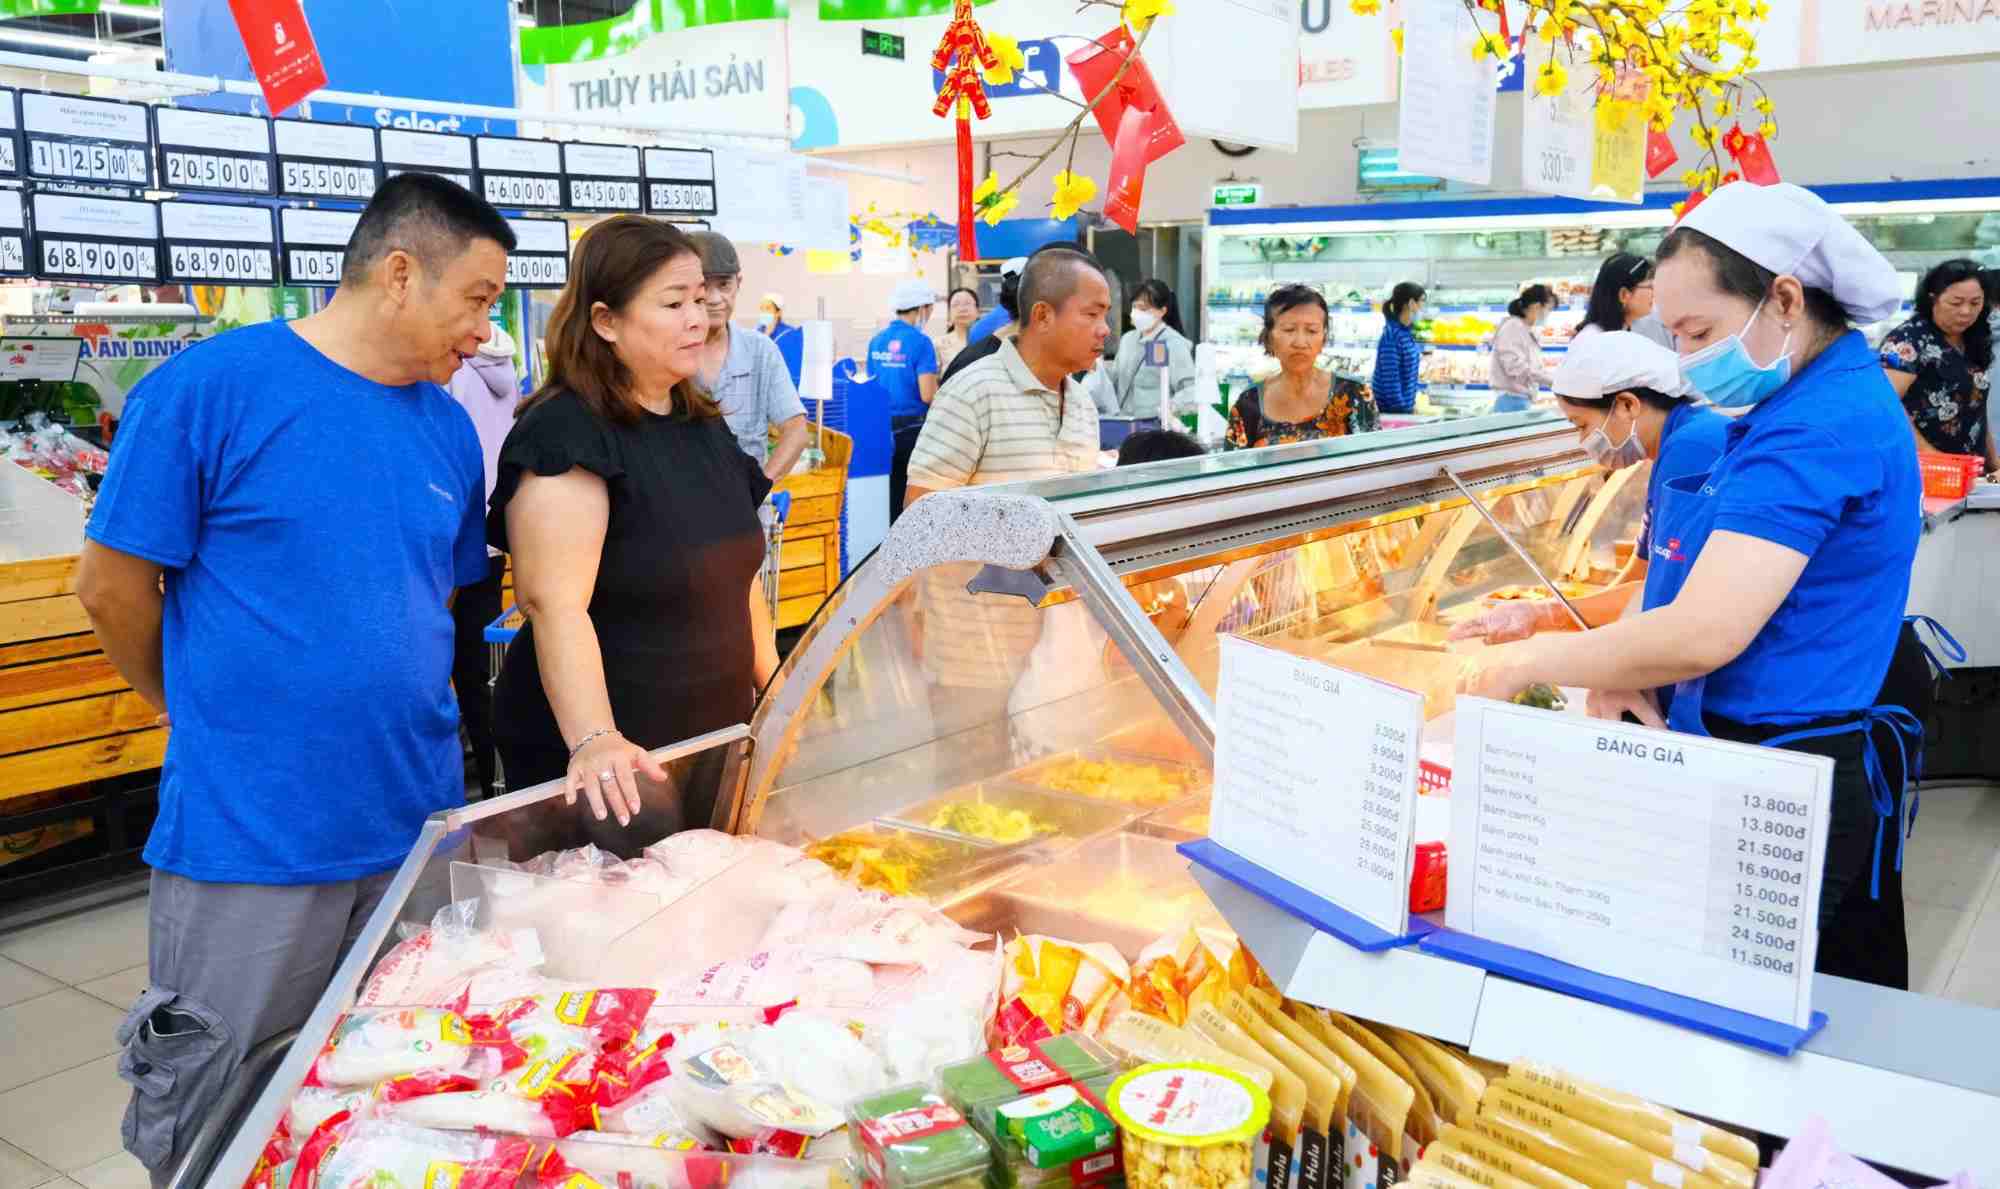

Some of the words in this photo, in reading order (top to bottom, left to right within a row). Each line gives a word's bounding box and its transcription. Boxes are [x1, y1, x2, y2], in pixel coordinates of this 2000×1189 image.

[649, 60, 696, 103] HẢI
[704, 53, 765, 98] SẢN
[169, 158, 250, 183] 20.500
[287, 167, 357, 191] 55.500
[487, 181, 545, 200] 46.000
[47, 247, 134, 271] 68.900
[174, 252, 252, 273] 68.900
